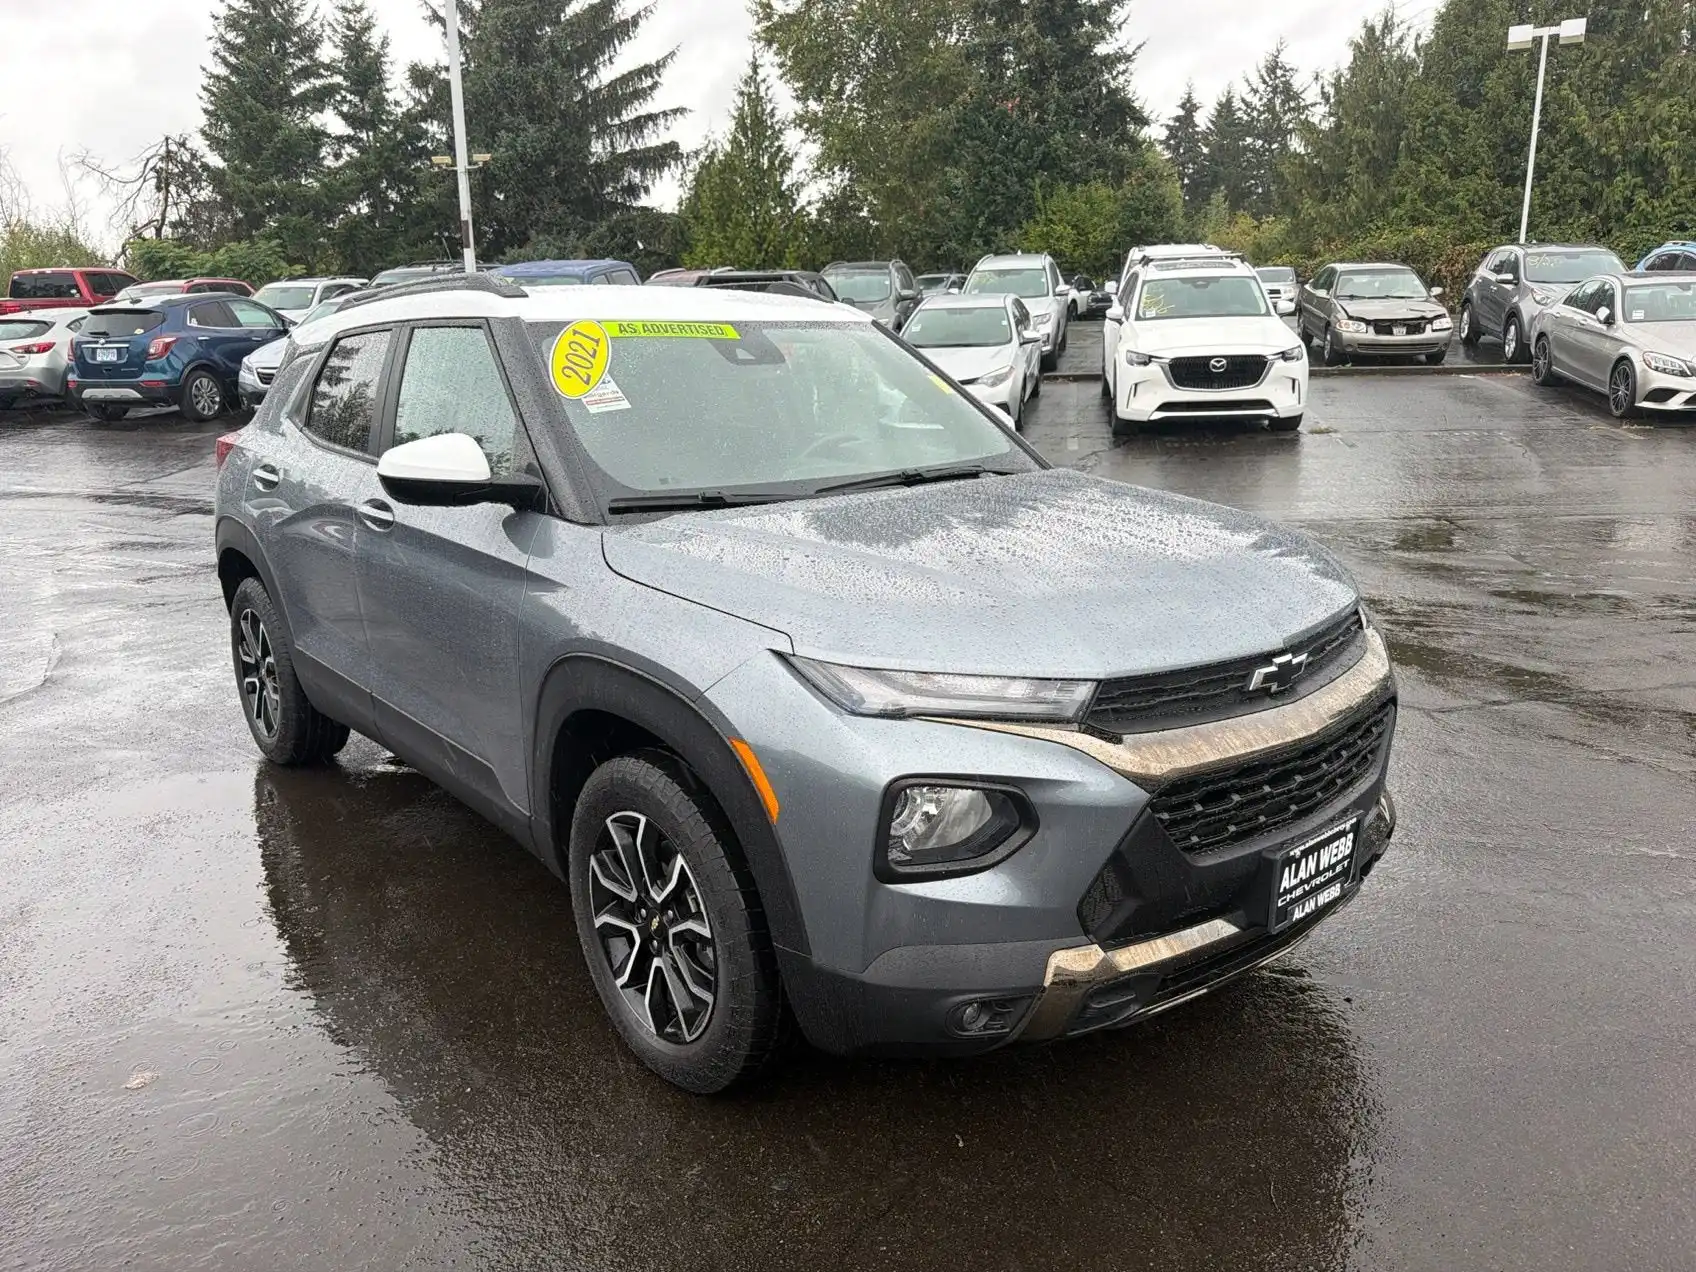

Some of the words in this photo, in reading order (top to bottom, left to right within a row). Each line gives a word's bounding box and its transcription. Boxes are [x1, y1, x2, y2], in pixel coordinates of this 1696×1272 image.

[618, 322, 638, 335] AS
[642, 323, 726, 337] ADVERTISED
[561, 328, 601, 386] 2021
[1277, 858, 1351, 907] CHEVROLET
[1280, 851, 1318, 893] ALAN
[1319, 832, 1354, 871] WEBB
[1293, 896, 1316, 922] ALAN
[1317, 882, 1341, 907] WEBB
